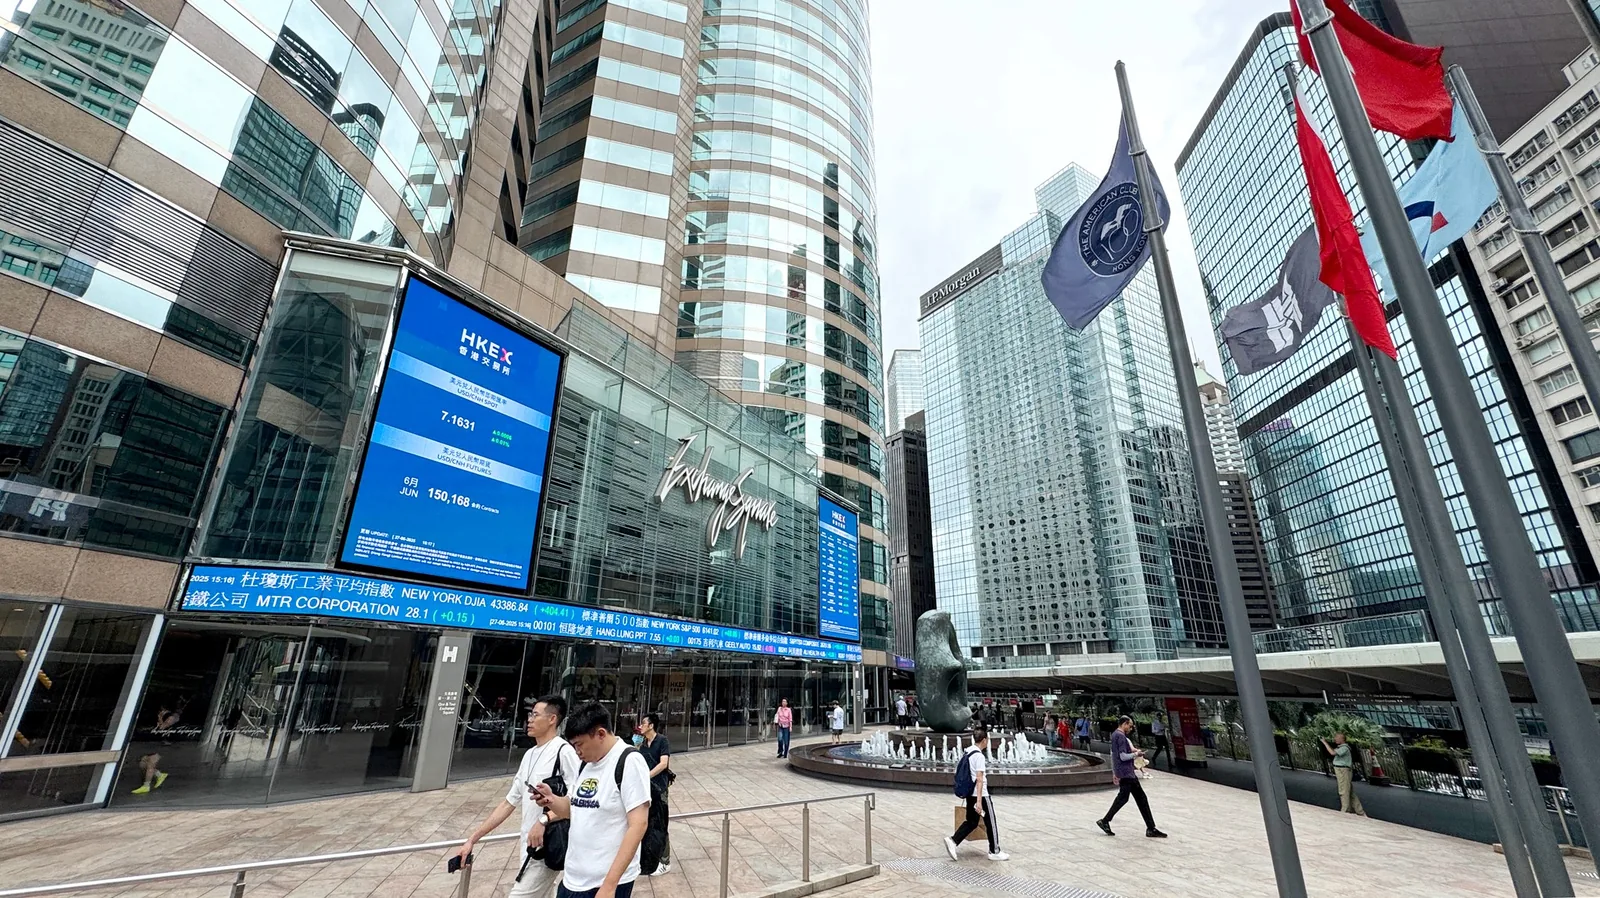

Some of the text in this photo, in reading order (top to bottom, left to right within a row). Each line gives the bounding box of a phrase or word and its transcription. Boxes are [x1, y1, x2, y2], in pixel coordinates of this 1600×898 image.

[1081, 185, 1138, 257] THE AMERICAN CLUB
[460, 327, 514, 365] HKEX
[459, 345, 511, 376] 香港交易所
[457, 388, 499, 409] USD/CNH SPOT
[441, 410, 476, 432] 7.1631
[437, 453, 492, 476] USD/CNH FUTURES
[399, 486, 419, 498] JUN
[403, 476, 419, 488] 6月
[653, 434, 745, 549] Exchange
[428, 487, 470, 508] 150,168
[240, 571, 395, 600] 杜瓊斯工業平均指數
[401, 587, 432, 601] NEW
[432, 590, 462, 605] YORK
[464, 595, 486, 608] DJIA
[490, 598, 529, 613] 43386.84
[651, 619, 664, 629] NEW
[665, 621, 680, 631] YORK
[256, 594, 291, 608] MTR
[295, 595, 400, 617] CORPORATION
[405, 606, 428, 619] 28.1
[533, 620, 556, 632] 00101
[595, 627, 615, 637] HANG
[616, 629, 634, 639] LUNG
[634, 630, 647, 641] PPT
